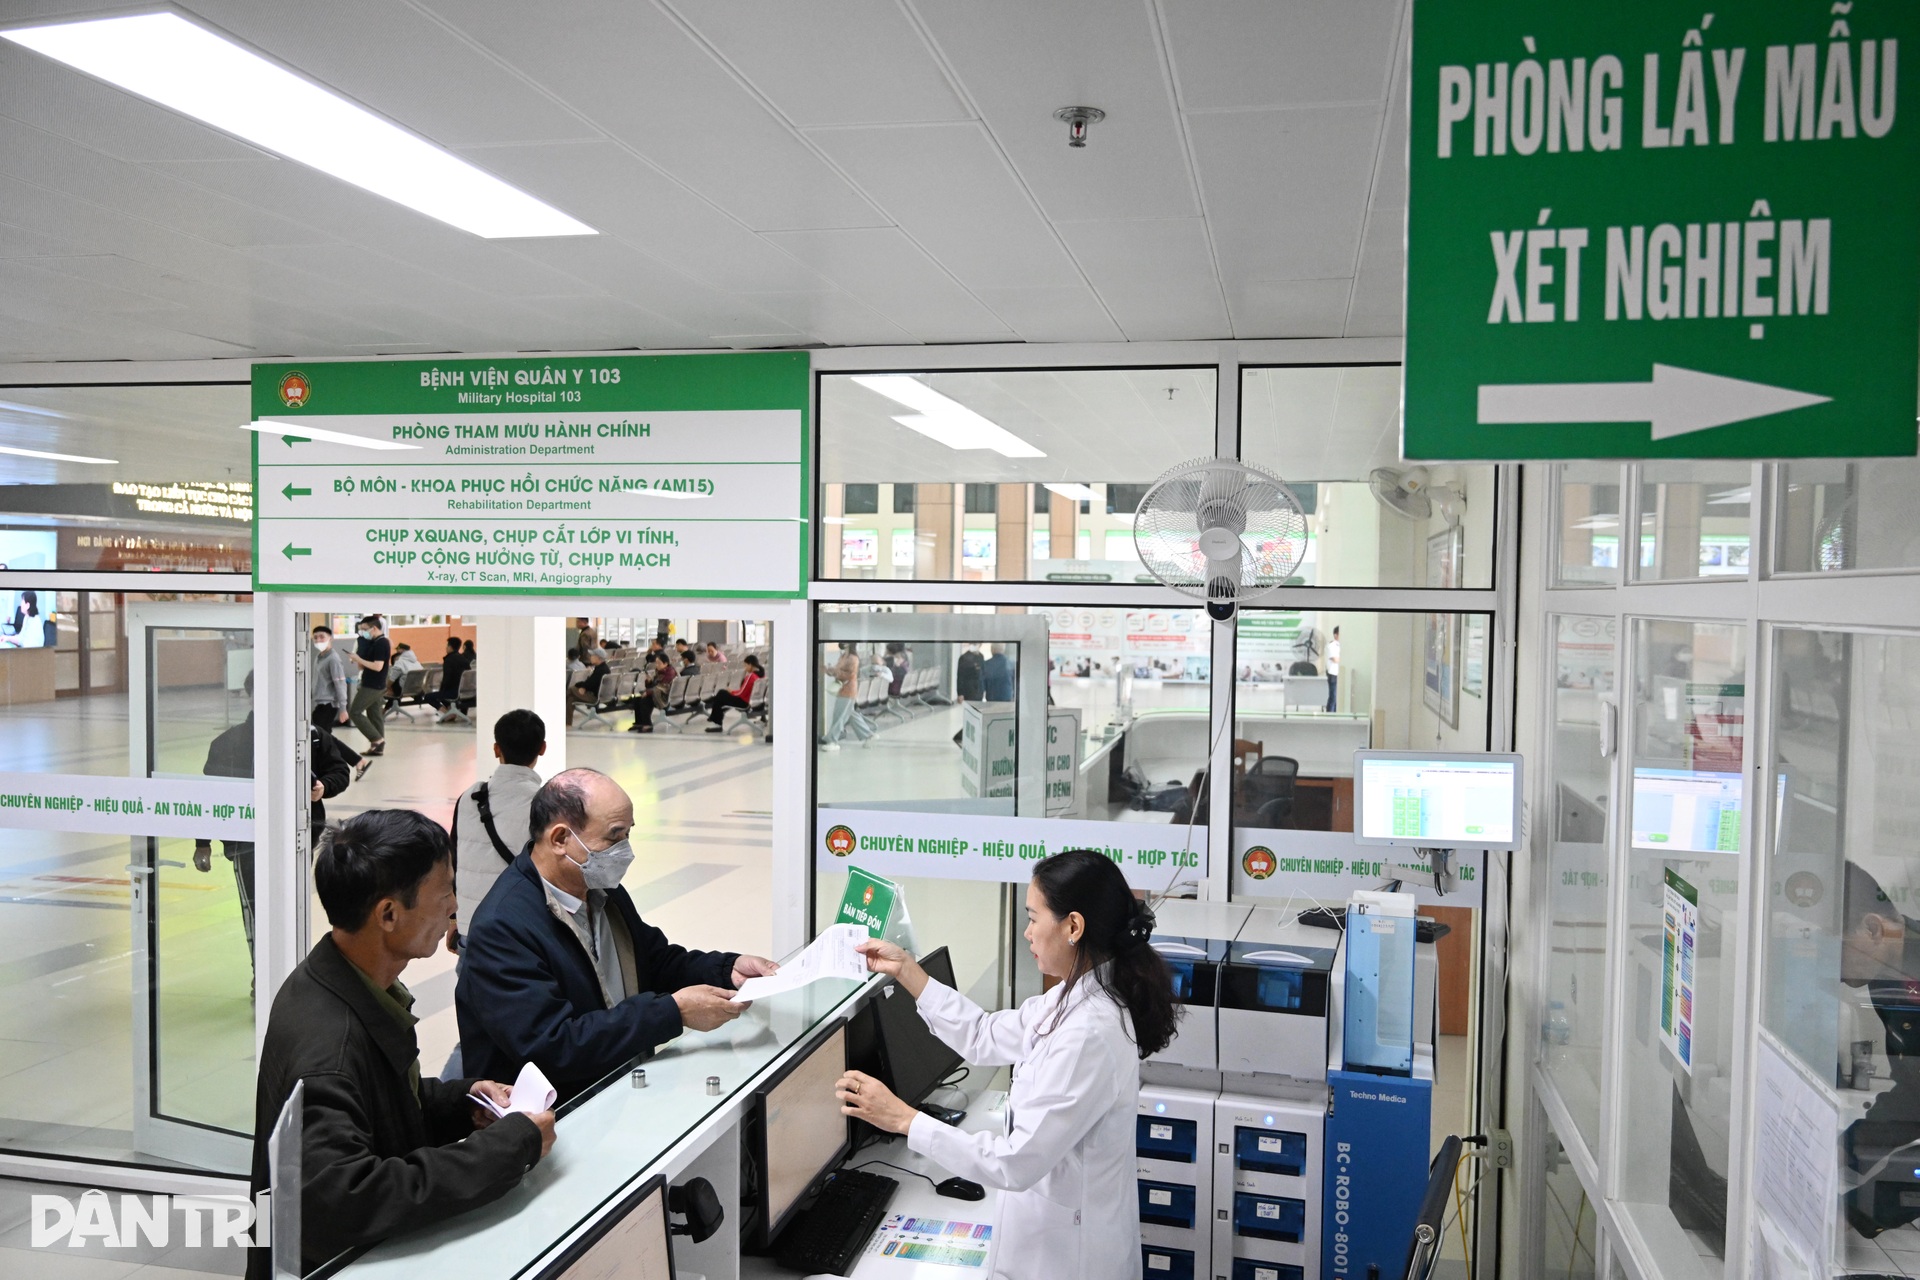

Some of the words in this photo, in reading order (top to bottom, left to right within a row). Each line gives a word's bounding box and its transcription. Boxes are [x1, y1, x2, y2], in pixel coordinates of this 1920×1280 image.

[1438, 37, 1623, 158] PHÒNG
[1642, 14, 1745, 148] LẤY
[1764, 2, 1897, 142] MẪU
[1487, 209, 1588, 323] XÉT
[1605, 200, 1830, 339] NGHIỆM
[421, 368, 464, 390] BỆNH
[470, 367, 508, 389] VIỆN
[515, 366, 566, 385] QUÂN
[572, 369, 583, 384] Y
[590, 369, 620, 384] 103
[459, 393, 502, 405] Military
[506, 391, 555, 405] Hospital
[560, 391, 581, 402] 103
[393, 422, 449, 439] PHÒNG
[455, 425, 498, 438] THAM
[505, 423, 539, 438] MƯU
[545, 421, 591, 437] HÀNH
[597, 420, 650, 437] CHÍNH
[446, 445, 525, 454] Administration
[530, 445, 594, 456] Department
[334, 476, 355, 496] BỘ
[361, 476, 396, 492] MÔN
[412, 479, 456, 492] KHOA
[462, 479, 505, 496] PHỤC
[511, 472, 539, 492] HỒI
[545, 475, 593, 492] CHỨC
[598, 474, 649, 493] NĂNG
[653, 478, 715, 496] (AM15)
[448, 500, 522, 509] Rehabilitation
[527, 500, 591, 511] Department
[366, 529, 409, 546] CHỤP
[414, 530, 487, 545] XQUANG,
[493, 530, 537, 548] CHỤP
[543, 524, 575, 543] CẮT
[581, 527, 610, 543] LỚP
[616, 531, 631, 543] VI
[637, 527, 678, 546] TÍNH,
[374, 551, 416, 567] CHỤP
[422, 548, 470, 568] CỘNG
[476, 546, 535, 565] HƯỞNG
[540, 549, 562, 568] TỪ,
[569, 553, 614, 570] CHỤP
[620, 553, 670, 570] MẠCH
[428, 571, 457, 583] X-ray,
[461, 572, 476, 581] CT
[480, 572, 509, 582] Scan,
[514, 572, 536, 582] MRI,
[540, 573, 612, 585] Angiography
[0, 793, 42, 810] CHUYÊN
[44, 796, 84, 814] NGHIỆP
[93, 796, 119, 816] HIỆU
[121, 797, 144, 815] QUẢ
[154, 802, 170, 816] AN
[172, 800, 202, 817] TOÀN
[212, 803, 236, 822] HỢP
[861, 835, 913, 852] CHUYÊN
[918, 838, 968, 858] NGHIỆP
[983, 840, 1014, 860] HIỆU
[1018, 839, 1047, 860] QUẢ
[1138, 849, 1166, 868] HỢP
[1169, 848, 1200, 869] TÁC
[1281, 856, 1311, 872] CHUYÊN
[1314, 858, 1343, 877] NGHIỆP
[1351, 858, 1371, 877] HIỆU
[1349, 1090, 1377, 1101] Techno
[1378, 1093, 1407, 1104] Medica
